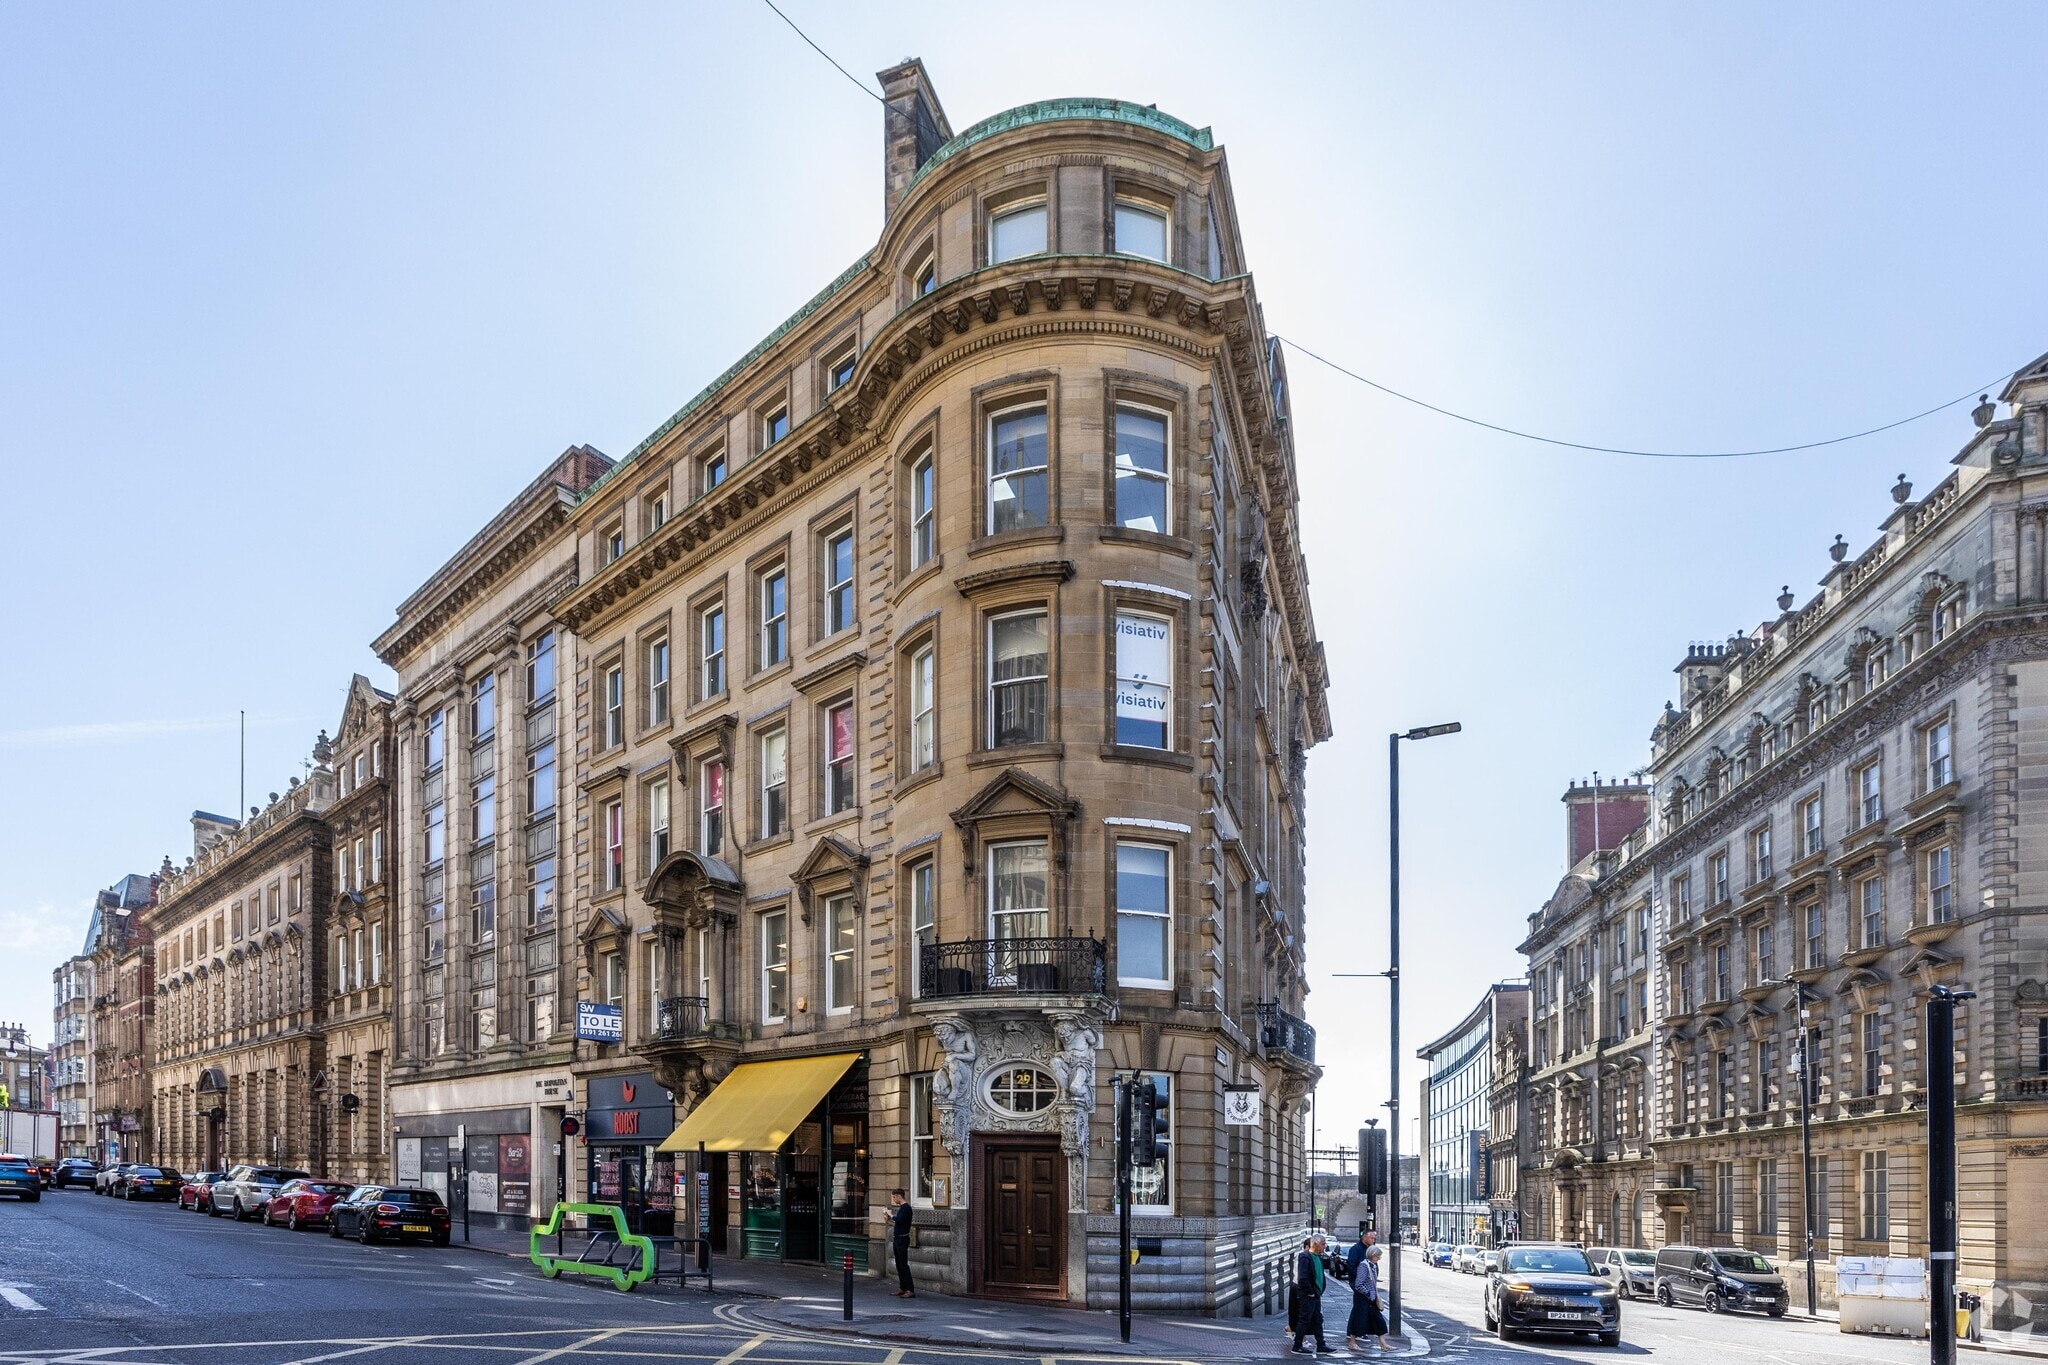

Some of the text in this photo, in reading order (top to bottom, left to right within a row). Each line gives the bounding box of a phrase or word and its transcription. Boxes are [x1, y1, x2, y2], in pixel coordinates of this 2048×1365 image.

[581, 1016, 599, 1026] TO
[1016, 1074, 1031, 1084] 29
[614, 1111, 638, 1134] ROOST
